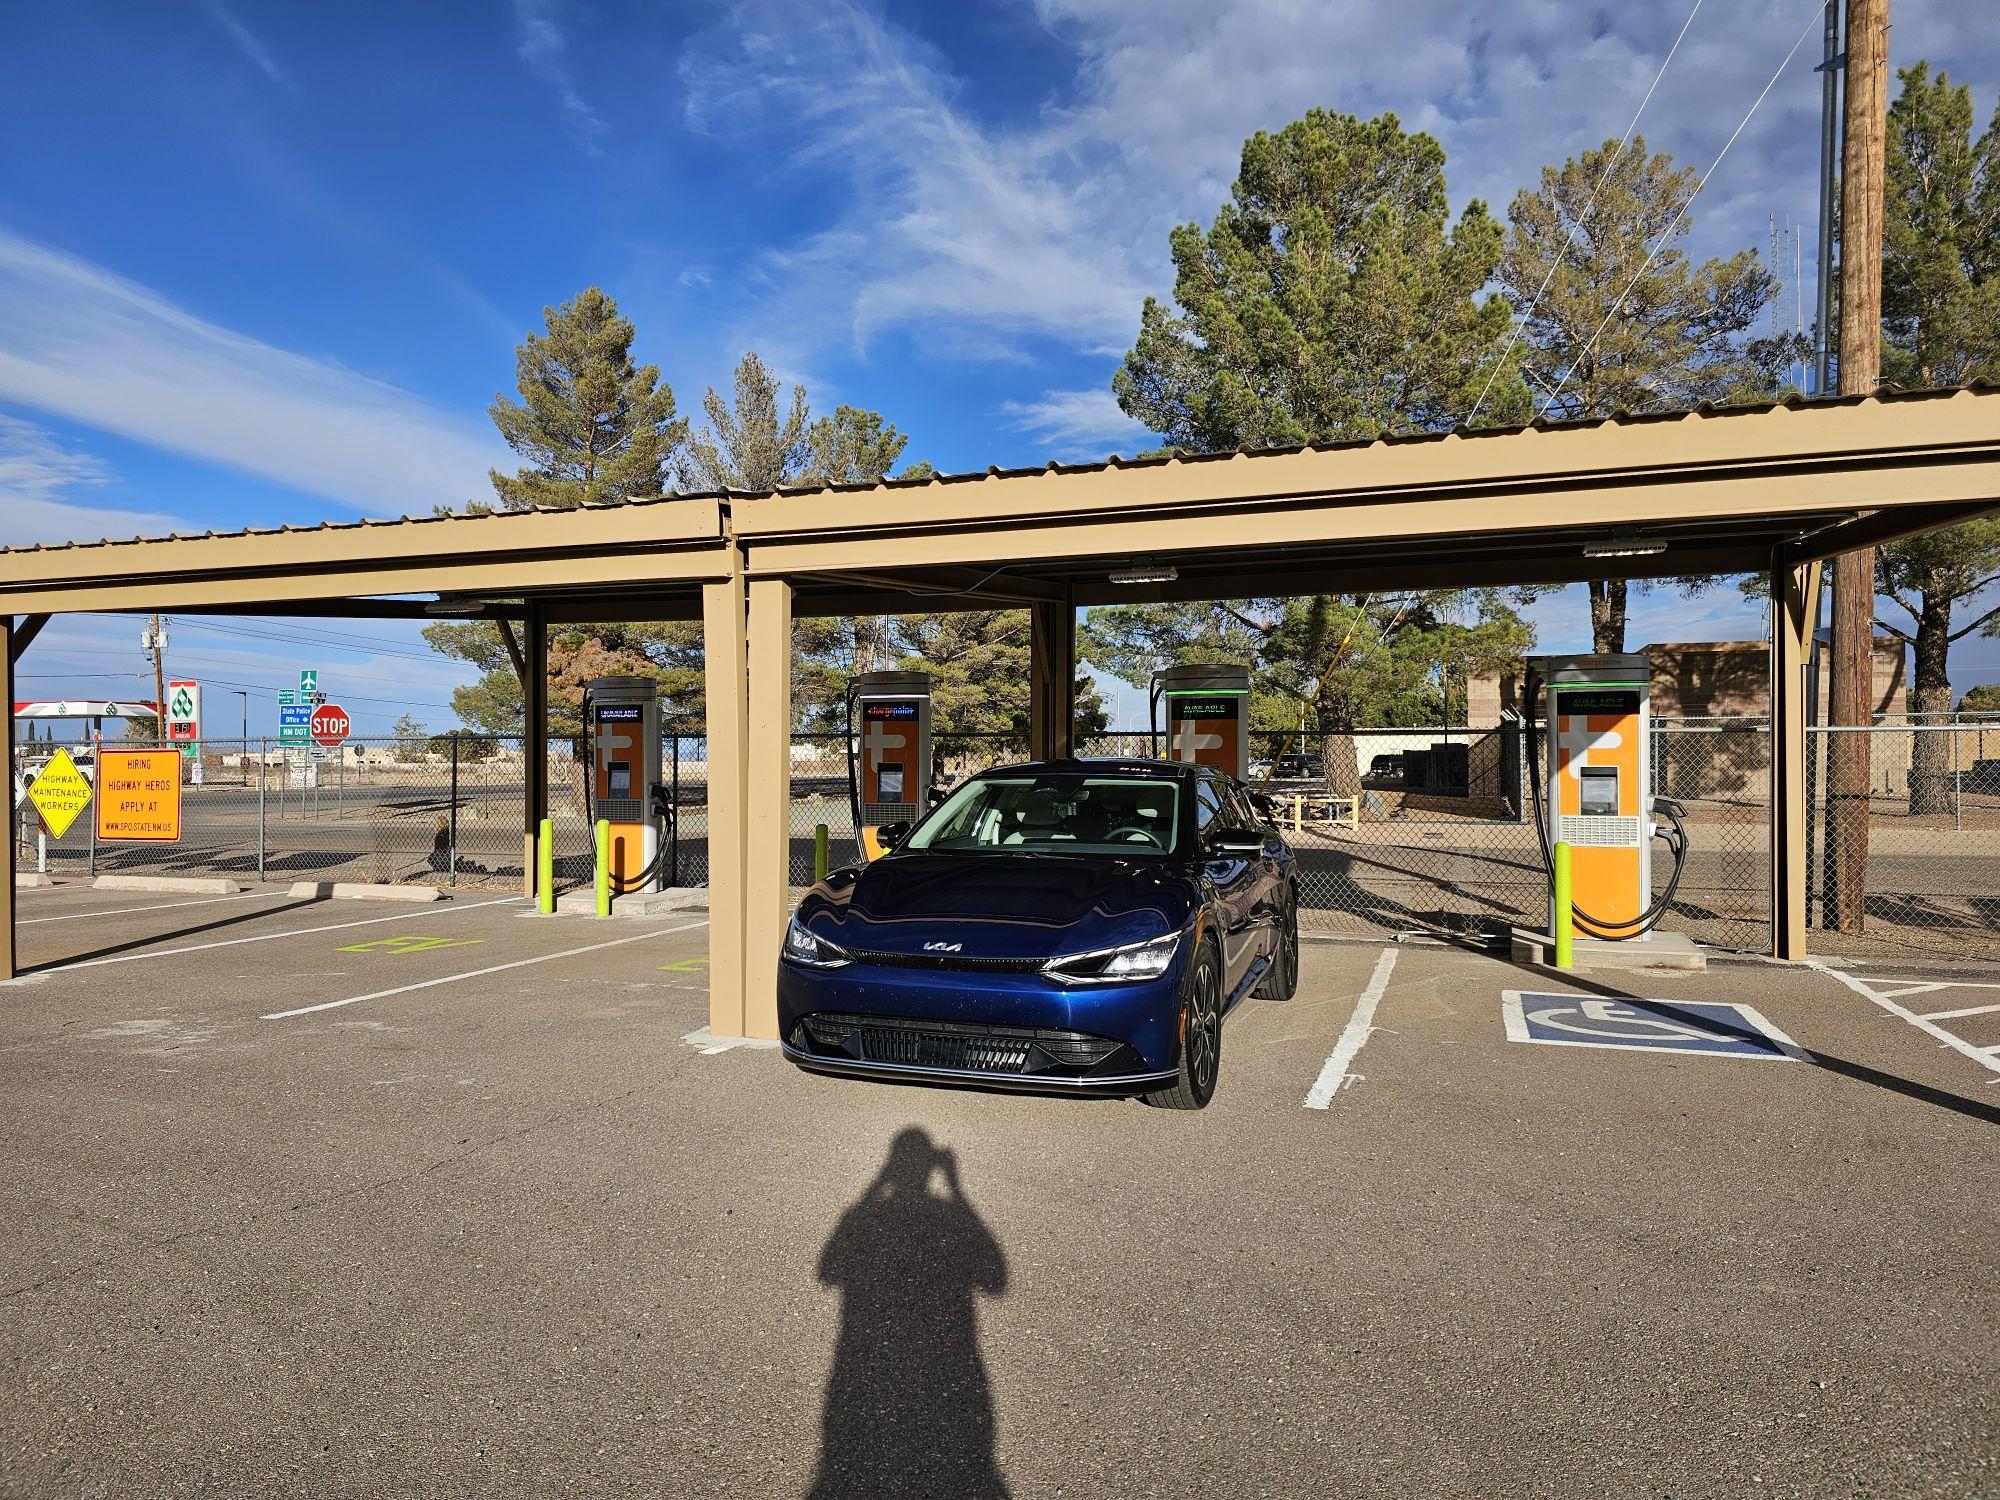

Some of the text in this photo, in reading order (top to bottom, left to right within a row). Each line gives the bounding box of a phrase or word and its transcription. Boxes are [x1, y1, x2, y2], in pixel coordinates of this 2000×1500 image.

[1571, 698, 1624, 707] AVAILABLE
[601, 710, 638, 718] UNAVAILABLE
[1183, 705, 1226, 713] AVAILABLE
[312, 717, 348, 734] STOP
[128, 759, 151, 769] HIRING
[42, 775, 79, 784] HIGHWAY
[108, 780, 171, 791] HIGHWAY HEROS
[33, 788, 88, 798] MAINTENANCE
[41, 801, 79, 811] WORKERS
[120, 801, 158, 812] APPLY AT
[106, 822, 171, 832] WWW.SPO.STATE.NM.US
[923, 941, 962, 951] KIA
